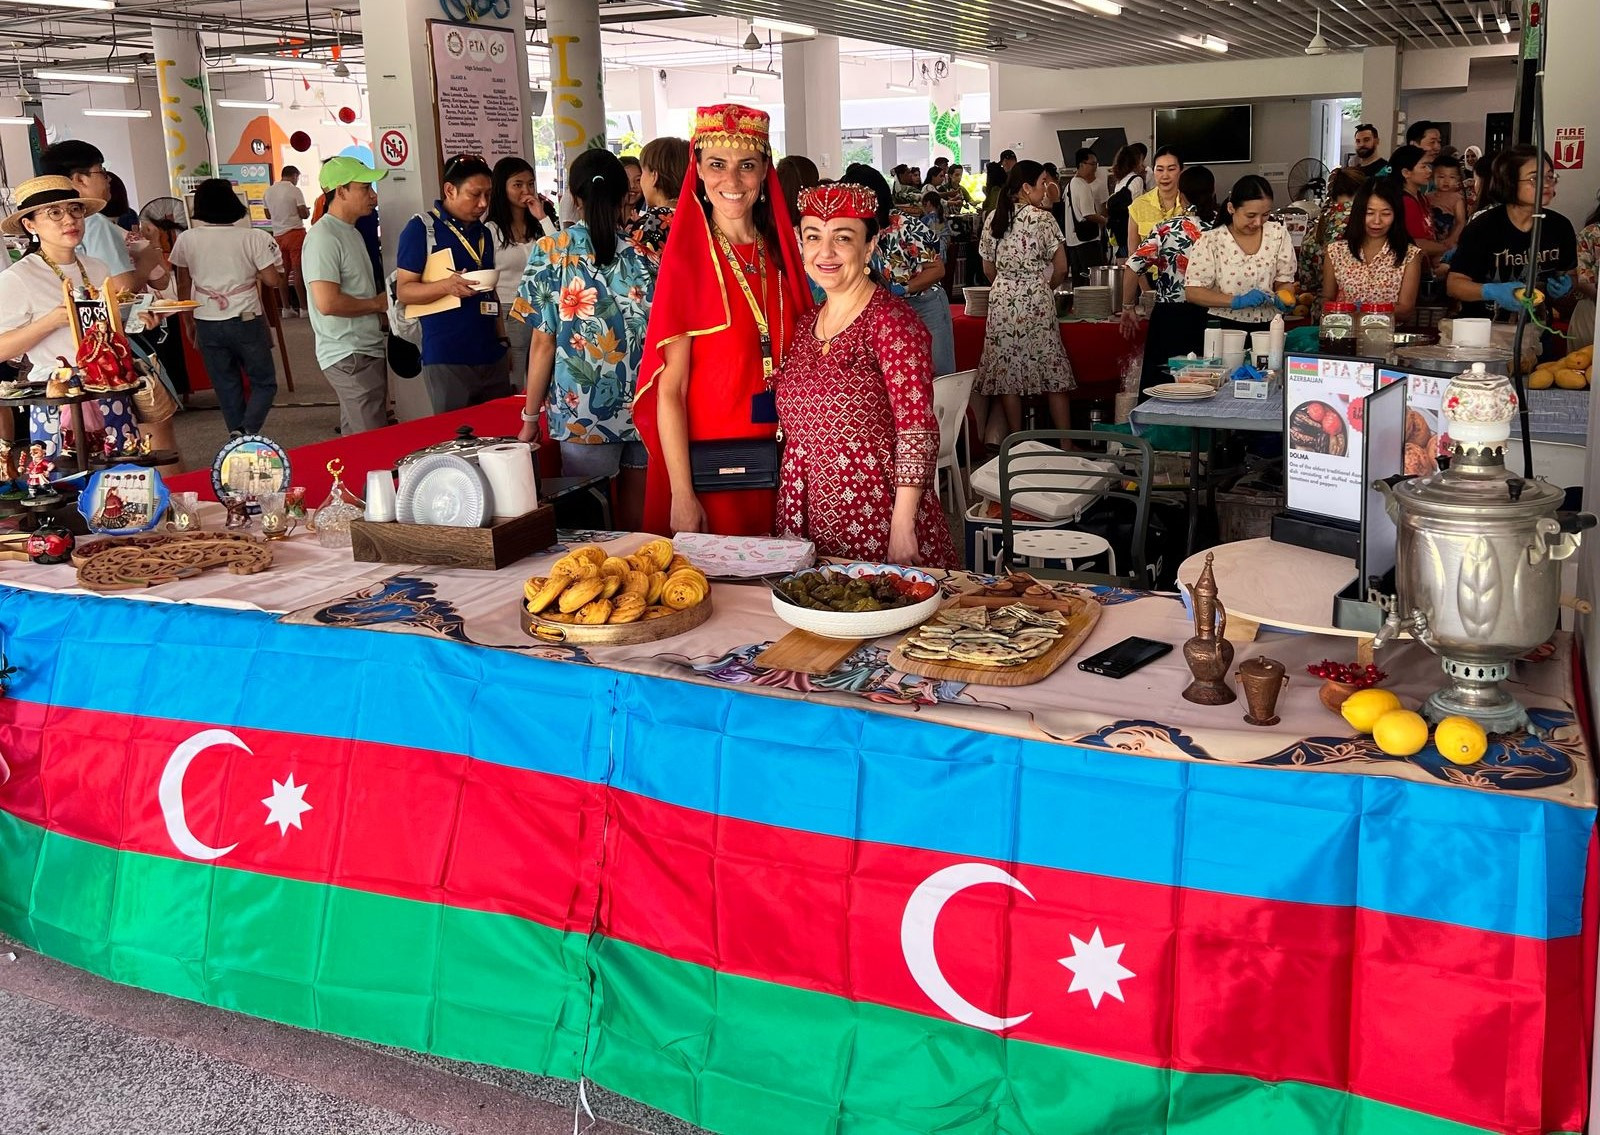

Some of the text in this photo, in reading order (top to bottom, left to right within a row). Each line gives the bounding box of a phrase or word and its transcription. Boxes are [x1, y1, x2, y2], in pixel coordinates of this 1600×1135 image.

[469, 40, 485, 52] PTA
[1557, 128, 1585, 136] FIRE
[1322, 361, 1350, 377] PTA
[1289, 375, 1324, 384] AZERBAIJAN
[1413, 377, 1440, 395] PTA
[1289, 452, 1309, 460] DOLMA
